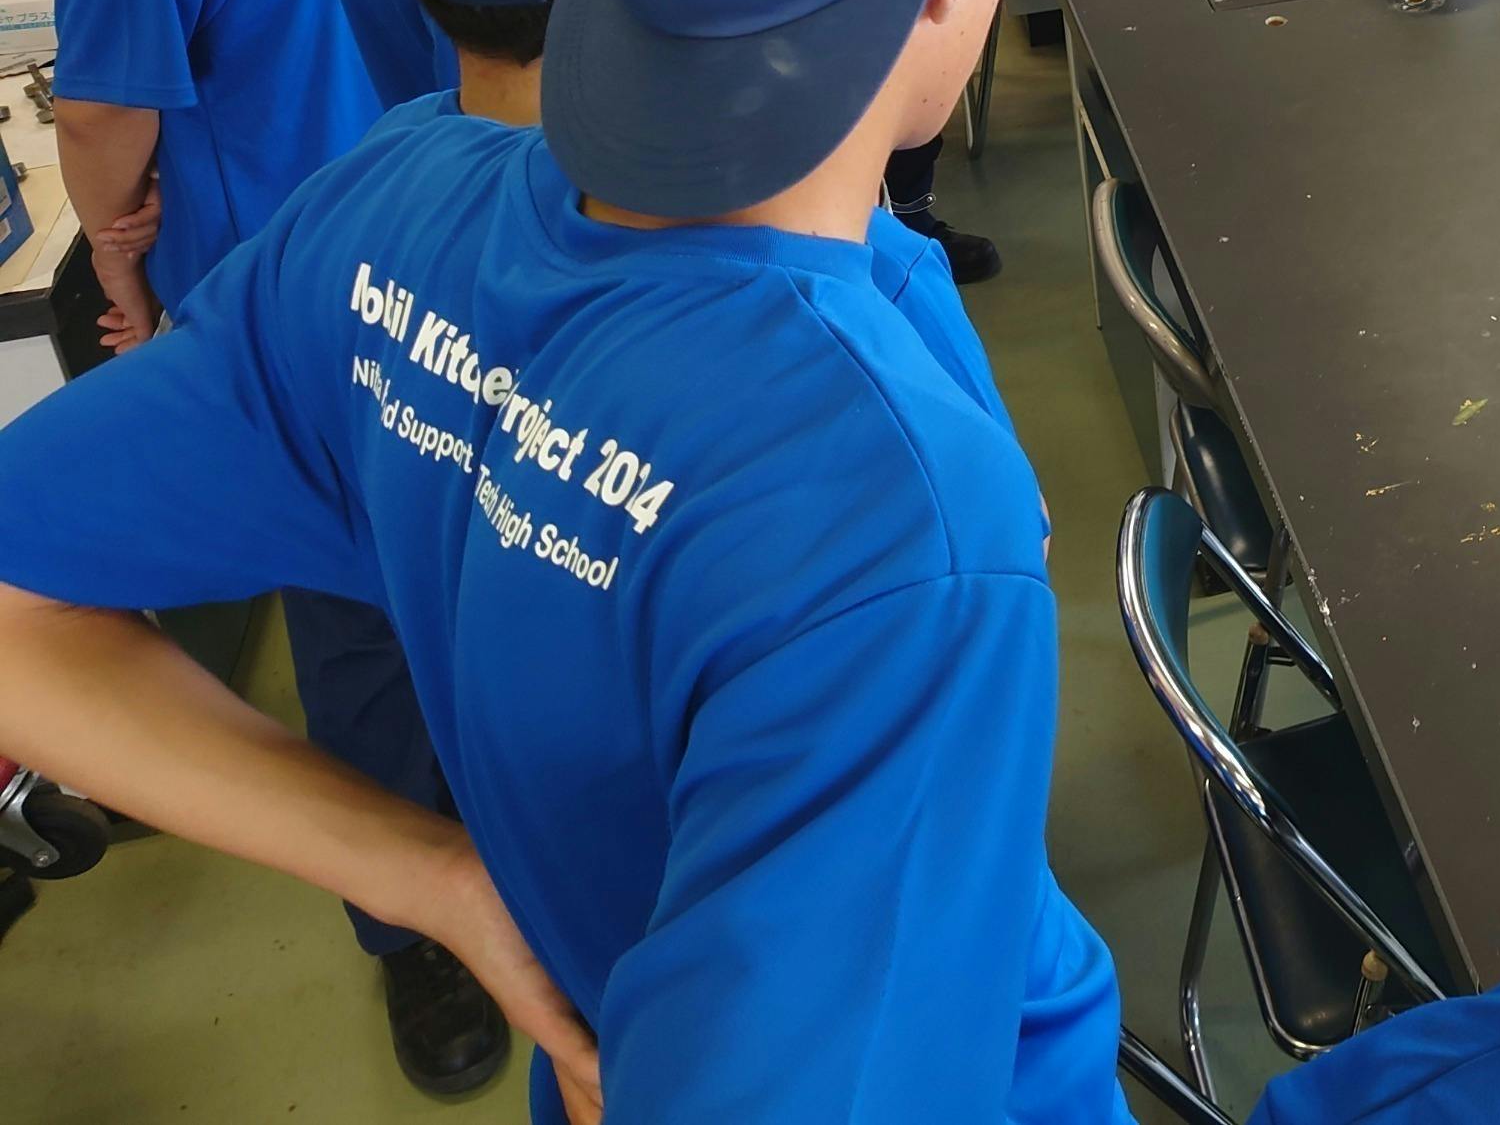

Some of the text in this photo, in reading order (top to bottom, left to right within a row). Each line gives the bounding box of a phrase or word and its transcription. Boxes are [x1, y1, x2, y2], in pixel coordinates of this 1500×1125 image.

[398, 405, 475, 474] Support
[475, 463, 501, 520] Tech
[491, 493, 534, 549] High
[534, 523, 619, 591] School
